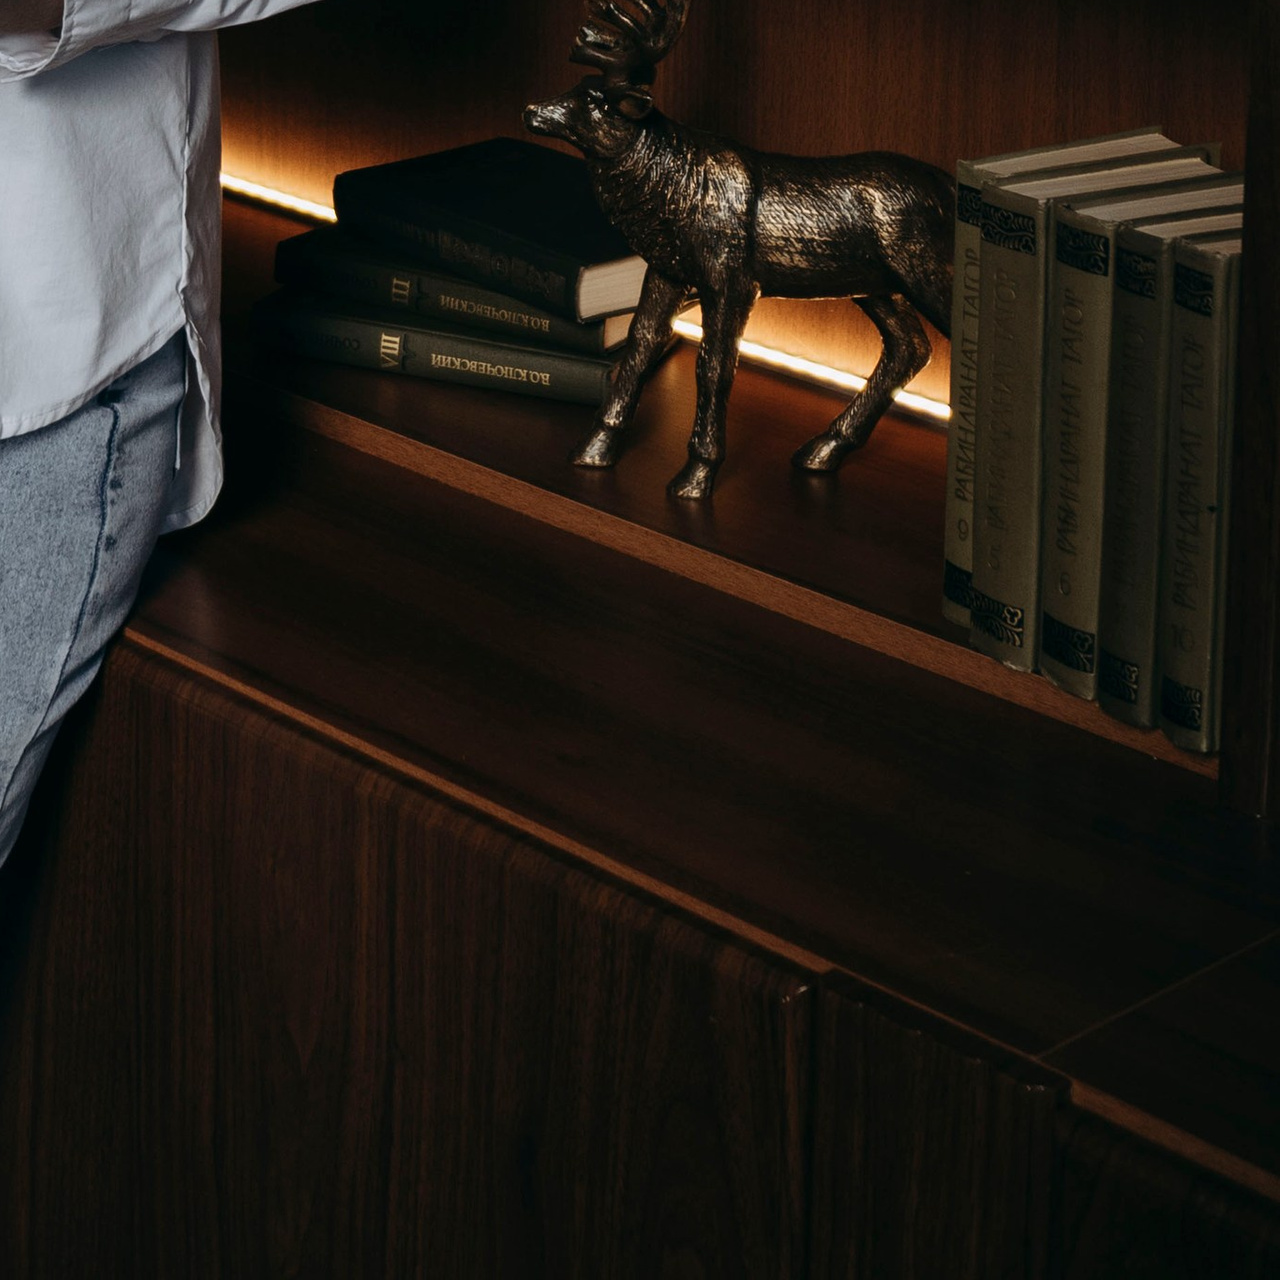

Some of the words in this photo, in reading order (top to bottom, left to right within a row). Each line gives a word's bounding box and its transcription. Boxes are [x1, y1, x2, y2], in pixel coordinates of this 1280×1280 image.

[440, 294, 550, 333] В.О.КЛЮЧЕВСКИЙ
[962, 247, 977, 320] ТАГОР
[997, 271, 1018, 341] ТАГОР
[380, 332, 401, 368] VIII
[1064, 289, 1085, 365] ТАГОР
[431, 353, 550, 386] В.О.КЛЮЧЕВСКИЙ
[1181, 339, 1205, 410] ТАГОР
[955, 335, 978, 502] РАБИНДРАНАТ
[1056, 378, 1082, 557] РАБИНДРАНАТ
[1172, 431, 1204, 611] РАБИНДРАНАТ
[1058, 571, 1071, 596] 6
